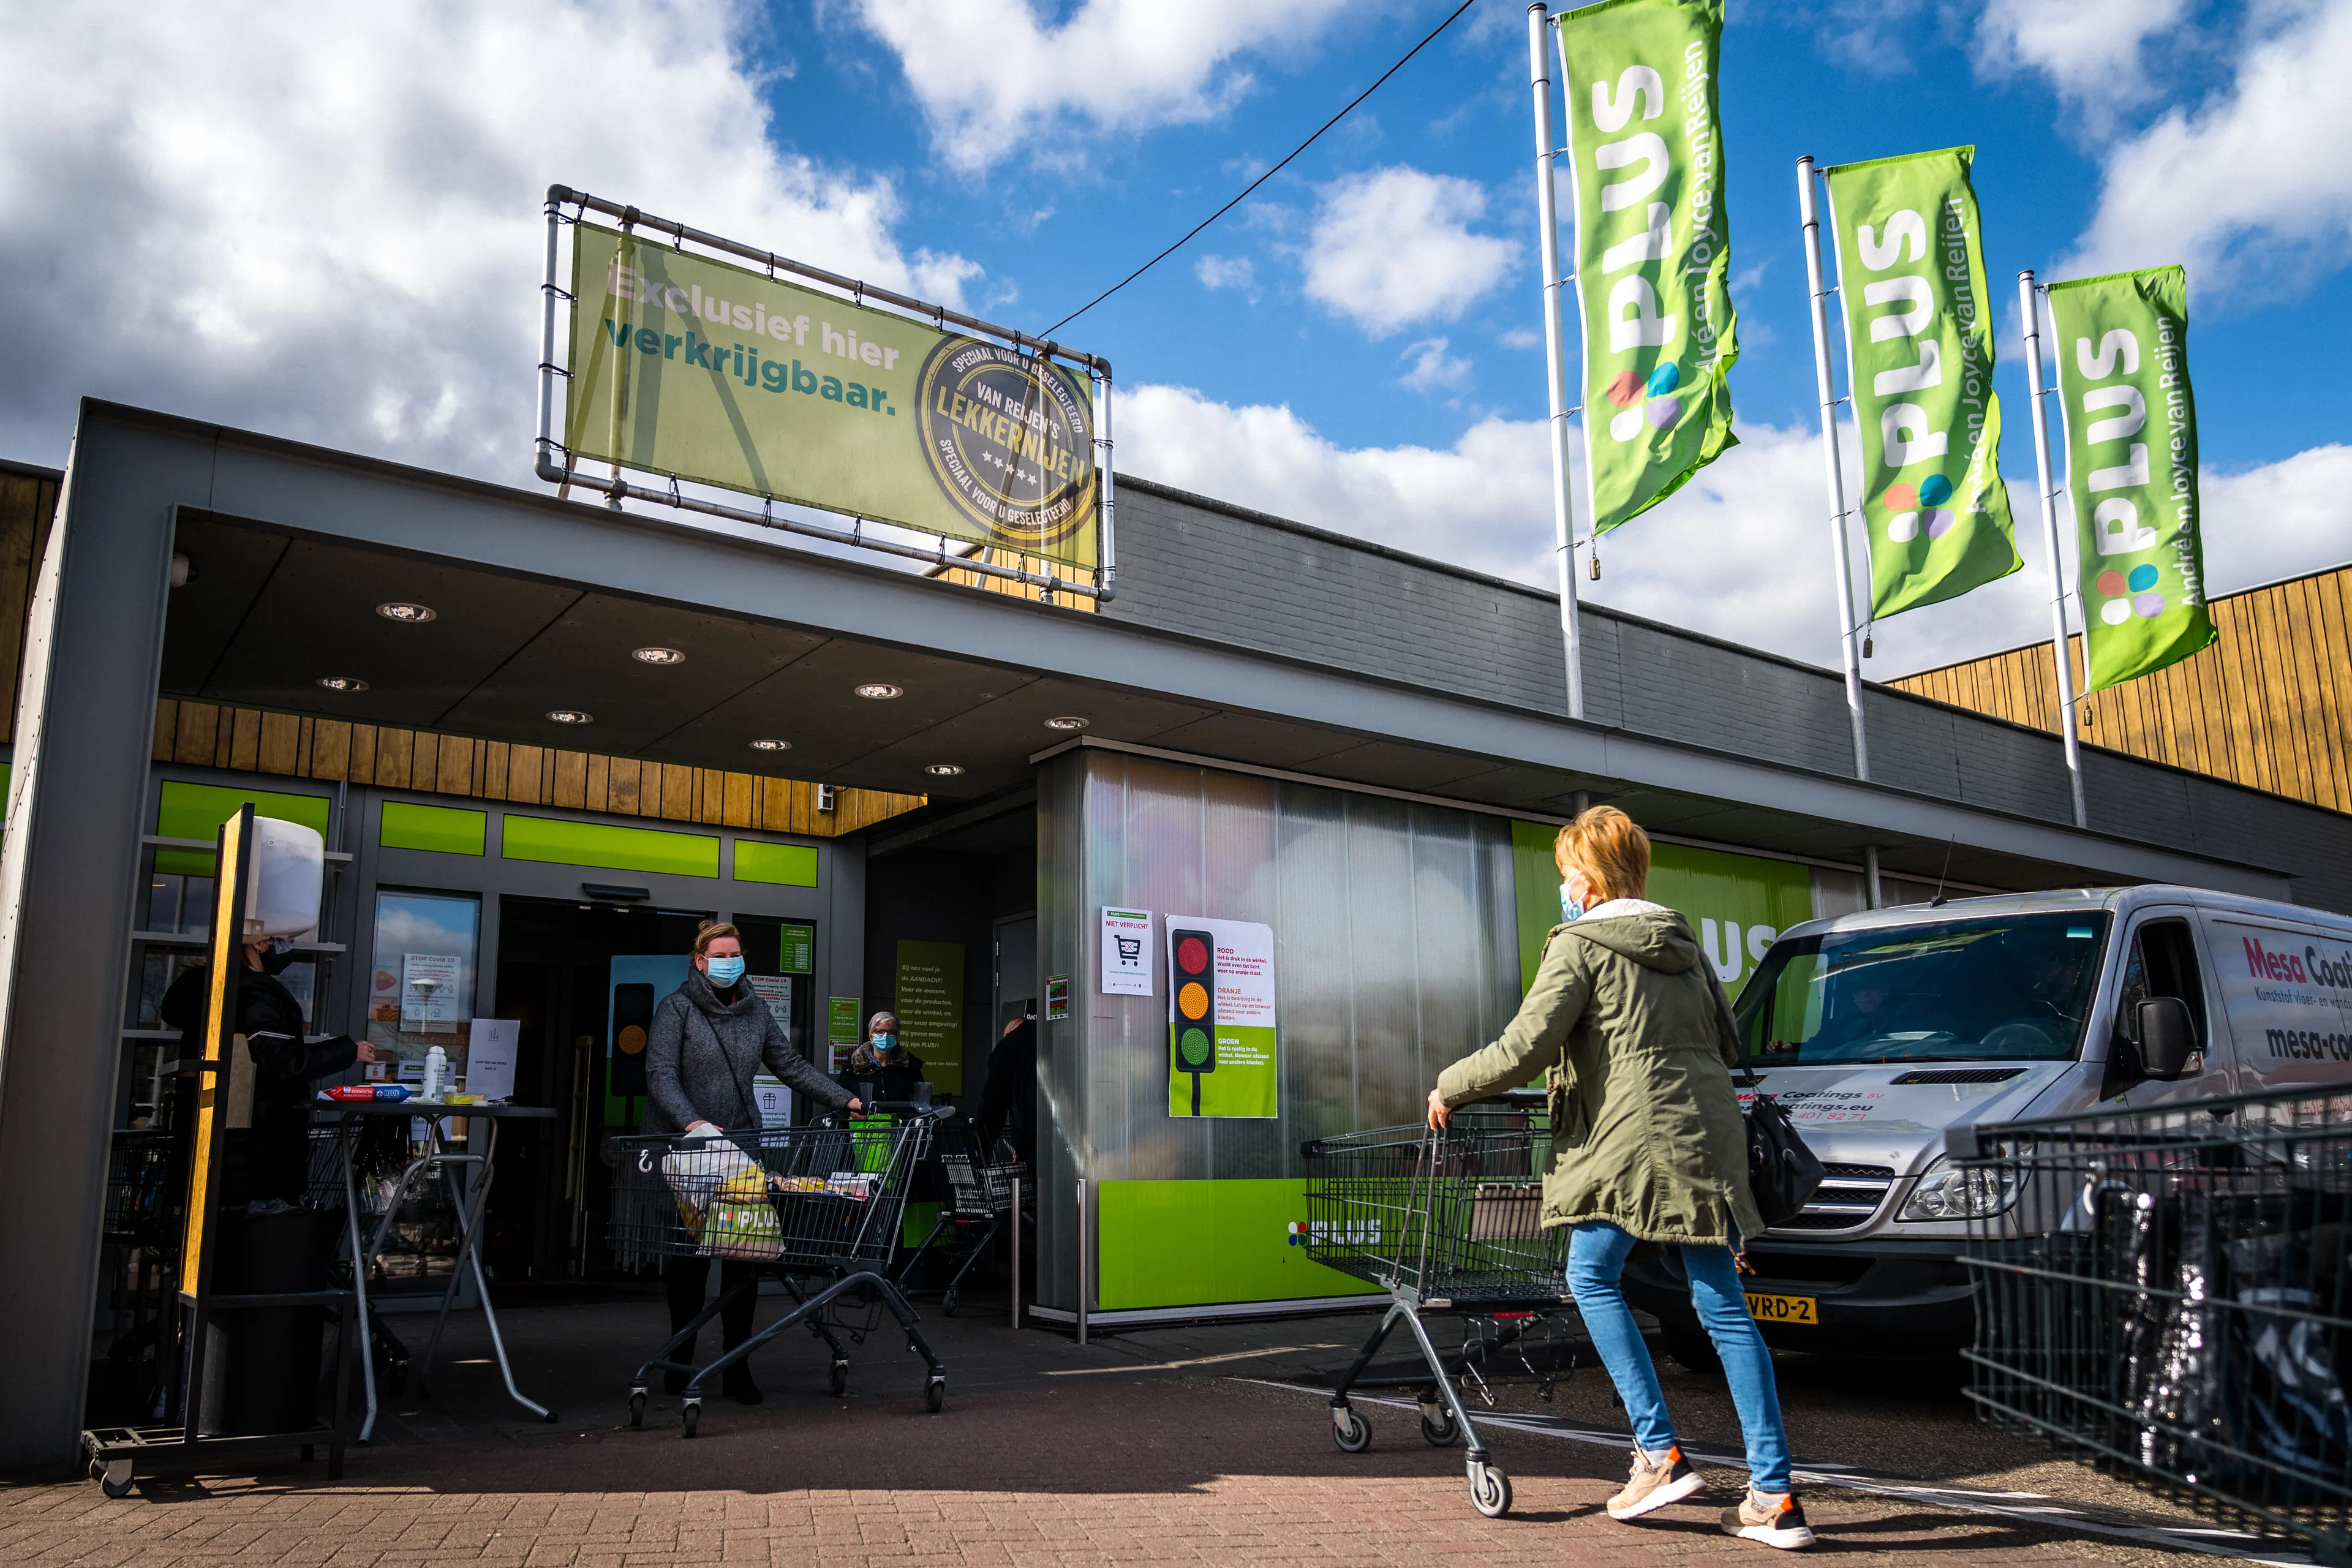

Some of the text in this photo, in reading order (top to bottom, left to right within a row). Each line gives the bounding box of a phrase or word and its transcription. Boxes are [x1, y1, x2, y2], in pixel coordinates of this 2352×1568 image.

[1680, 40, 1709, 137] Reijen
[1691, 130, 1711, 181] van
[1592, 65, 1676, 353] PLUS
[1686, 187, 1717, 276] Joyce
[1942, 198, 1970, 281] Reijen
[608, 263, 899, 370] Exclusief hier
[1694, 280, 1711, 322] en
[1858, 209, 1948, 467] PLUS
[1954, 285, 1976, 331] van
[605, 318, 895, 416] verkrijgbaar.
[952, 347, 1083, 434] SPECIAAL VOOR U GESELECTEERD
[1961, 334, 1983, 409] Joyce
[936, 385, 1085, 488] LEKKERNIJEN
[978, 382, 1060, 440] VAN REIJEN'S
[1967, 413, 1985, 445] en
[2076, 328, 2157, 556] PLUS
[940, 439, 1071, 526] SPECIAAL VOOR U GESELECTEERD
[2154, 317, 2203, 608] André en Joyce van Reijen
[1702, 918, 1776, 982] US
[2242, 937, 2307, 983] Mesa
[2255, 986, 2293, 1003] Kunststof
[2294, 990, 2316, 1006] vloer-
[2319, 997, 2328, 1007] en
[1783, 1091, 1863, 1100] Coatings
[1311, 1219, 1381, 1246] PLUS
[1747, 1295, 1811, 1321] VRD-2
